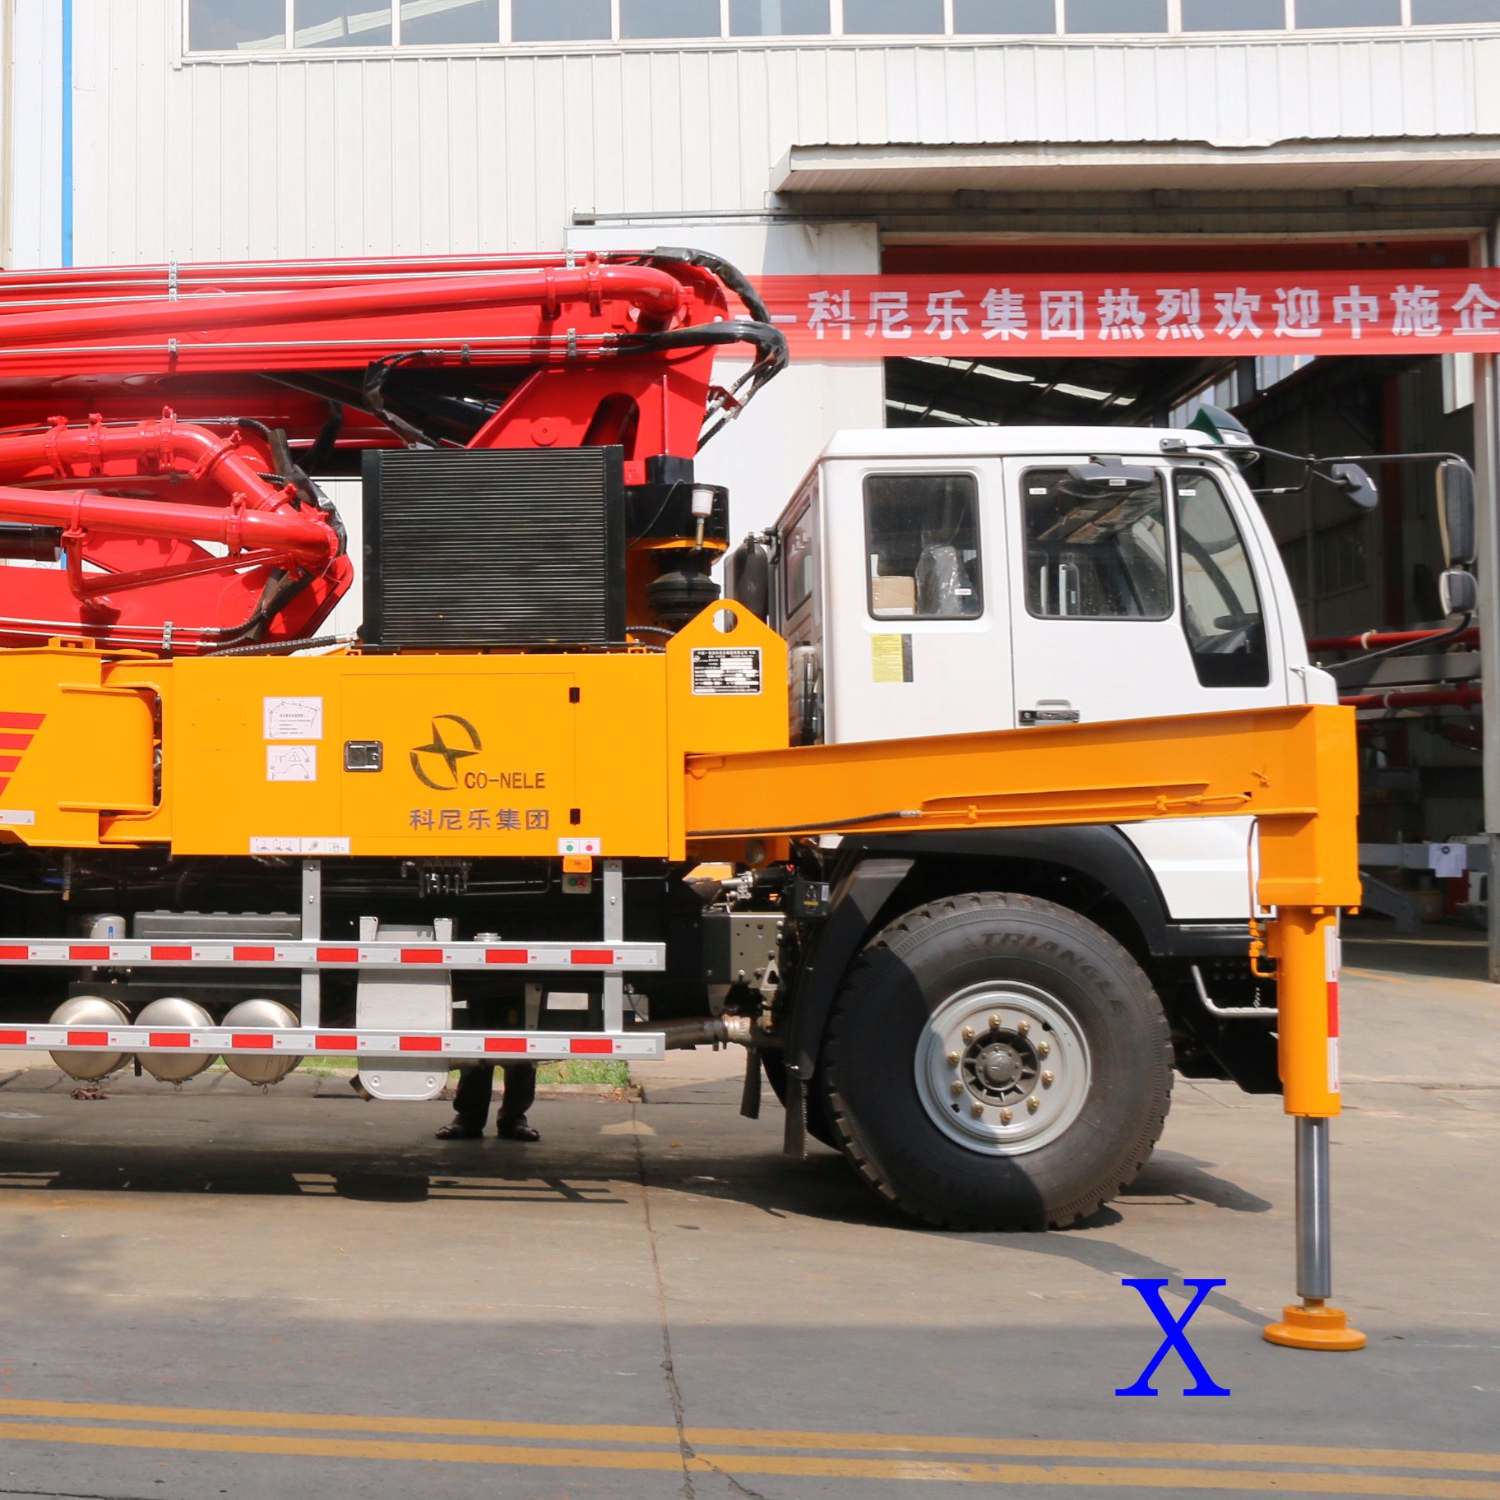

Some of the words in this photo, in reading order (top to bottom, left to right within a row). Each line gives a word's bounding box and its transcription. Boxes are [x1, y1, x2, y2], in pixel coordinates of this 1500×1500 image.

[464, 770, 546, 790] CO-NELE
[409, 808, 550, 831] 科尼乐集团
[981, 932, 1129, 1014] TRIANGLE
